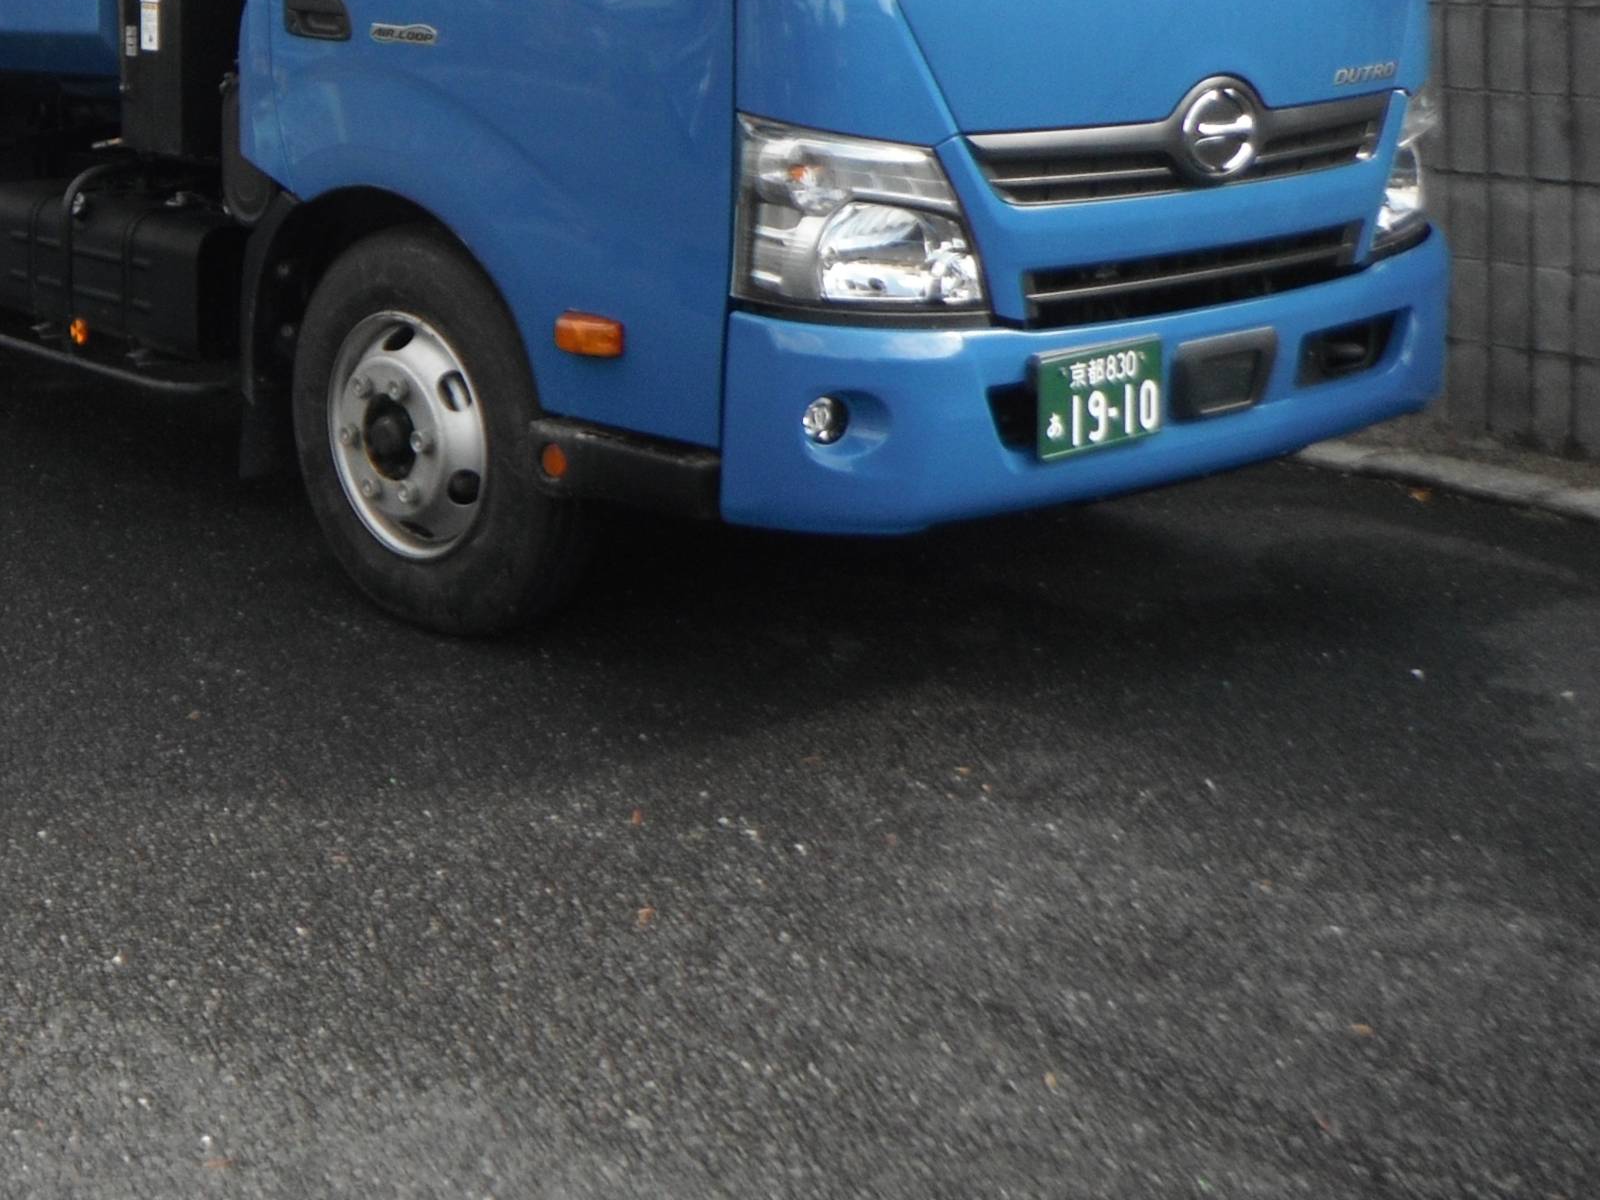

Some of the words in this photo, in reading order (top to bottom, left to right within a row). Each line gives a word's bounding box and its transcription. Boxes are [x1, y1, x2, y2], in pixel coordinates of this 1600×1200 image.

[1333, 61, 1397, 86] DUTRO
[1046, 412, 1064, 440] あ
[1071, 379, 1159, 448] 19-10
